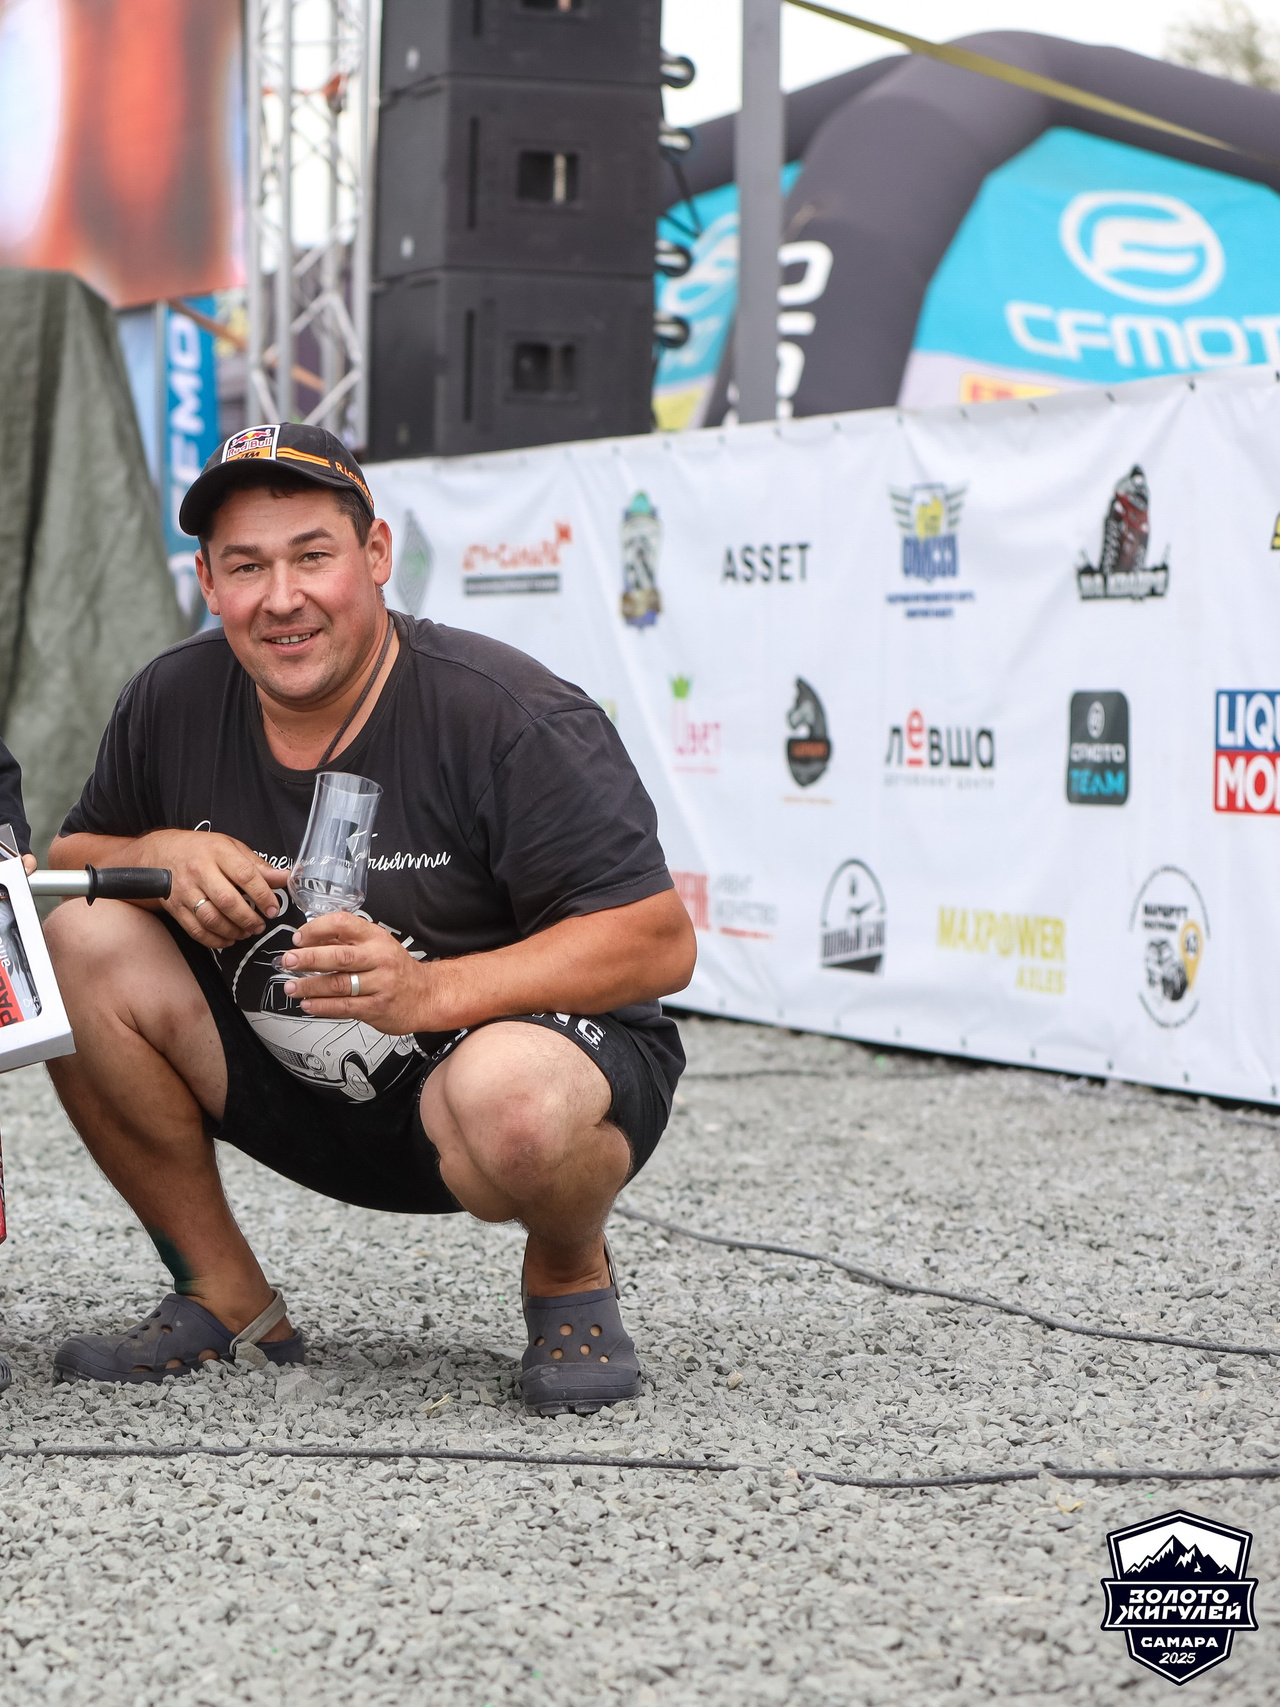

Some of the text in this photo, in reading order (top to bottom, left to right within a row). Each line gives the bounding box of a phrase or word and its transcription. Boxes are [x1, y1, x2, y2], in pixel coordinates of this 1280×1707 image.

[249, 436, 273, 449] Bull
[723, 543, 809, 582] ASSET
[1218, 692, 1280, 752] LIQ
[1071, 768, 1126, 796] TEAM
[1217, 755, 1280, 812] MO
[937, 905, 1066, 962] MAXPOWER
